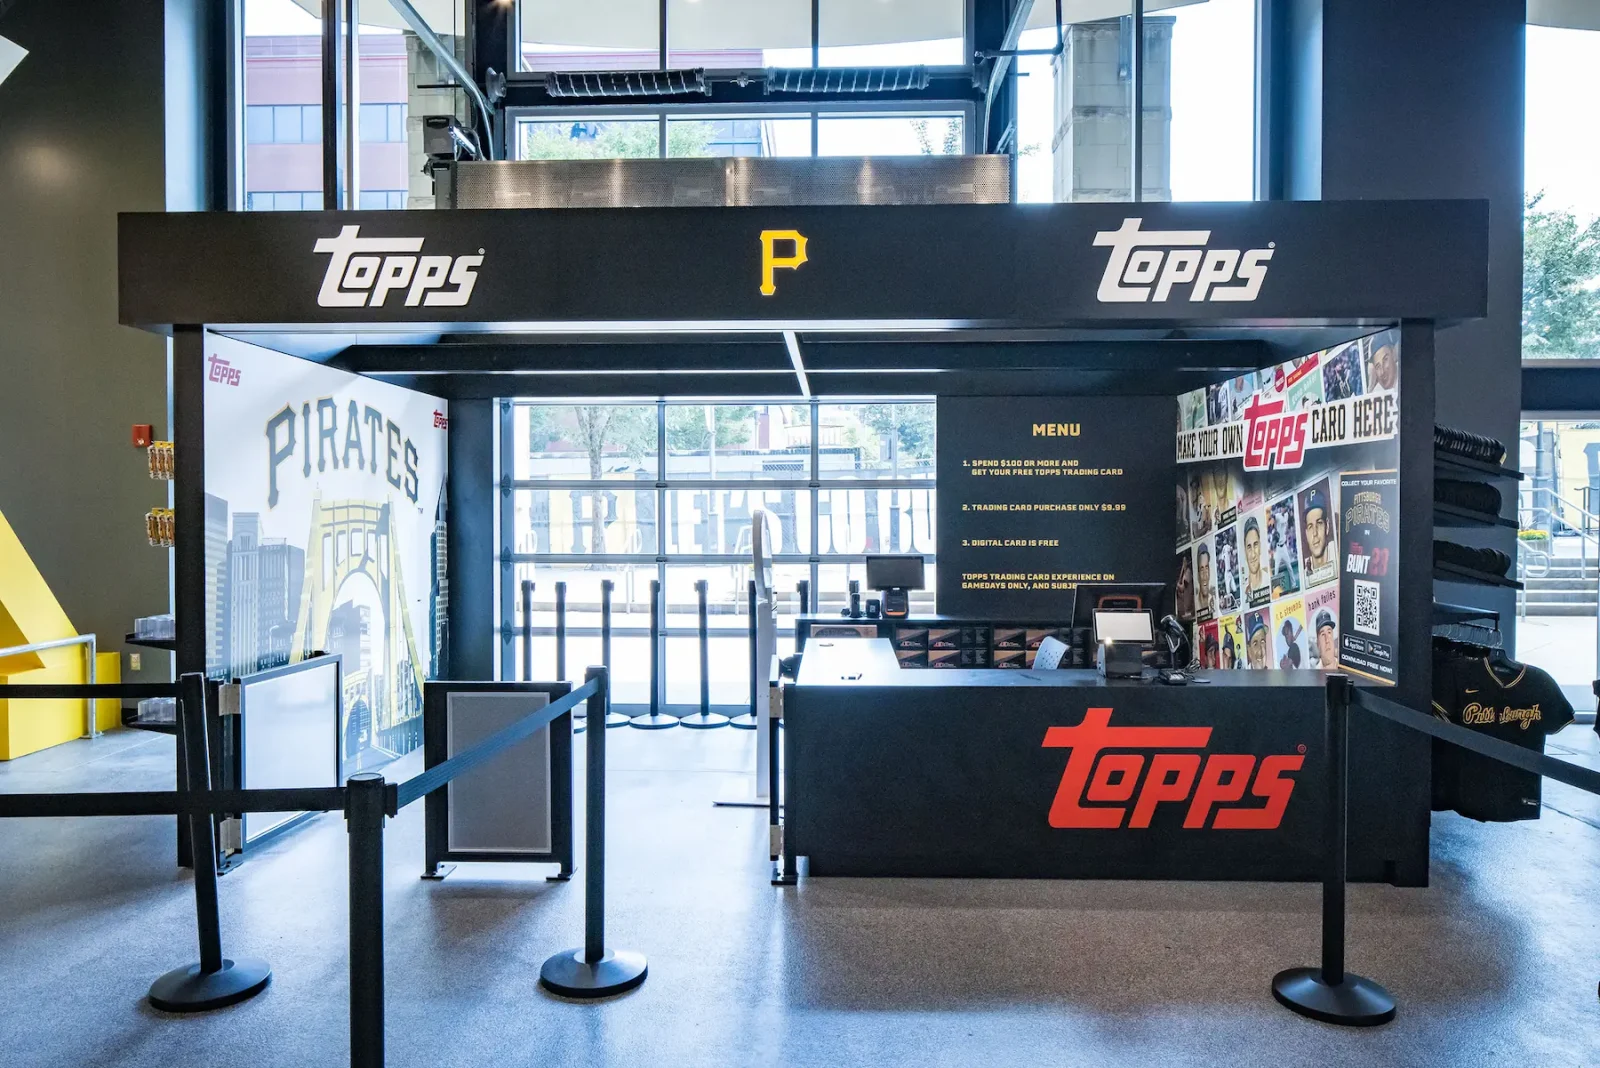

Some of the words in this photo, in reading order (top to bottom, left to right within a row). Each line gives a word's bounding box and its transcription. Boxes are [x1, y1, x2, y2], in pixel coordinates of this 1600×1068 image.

[760, 230, 808, 295] P
[1032, 423, 1081, 437] MENU
[1177, 432, 1196, 460] MAKE
[1199, 428, 1218, 457] YOUR
[1222, 424, 1243, 455] OWN
[1311, 403, 1346, 444] CARD
[264, 396, 419, 509] PIRATES
[962, 459, 971, 467] 1.
[972, 459, 999, 467] SPEND
[1000, 459, 1023, 468] $100
[1024, 459, 1036, 467] OR
[1037, 459, 1060, 467] MORE
[1061, 459, 1079, 467] AND
[971, 468, 988, 476] GET
[989, 468, 1011, 476] YOUR
[1012, 468, 1034, 476] FREE
[1035, 468, 1061, 476] TOPPS
[1062, 468, 1099, 476] TRADING
[1100, 468, 1124, 476] CARD
[1373, 478, 1396, 486] FAVORITE
[962, 503, 971, 511] 2.
[972, 503, 1008, 511] TRADING
[1009, 503, 1033, 511] CARD
[1033, 503, 1078, 511] PURCHASE
[1078, 503, 1100, 511] ONLY
[1101, 503, 1127, 512] $9.99
[1345, 503, 1390, 533] PIRATES
[962, 539, 971, 547] 3.
[971, 539, 1003, 547] DIGITAL
[1004, 539, 1027, 547] CARD
[1028, 539, 1037, 547] IS
[1038, 539, 1060, 547] FREE
[1346, 553, 1371, 575] BUNT
[961, 573, 989, 581] TOPPS
[989, 573, 1026, 581] TRADING
[1027, 573, 1050, 581] CARD
[1051, 573, 1102, 581] EXPERIENCE
[1103, 573, 1115, 581] ON
[961, 582, 1006, 590] GAMEDAYS
[1007, 582, 1031, 591] ONLY,
[1032, 582, 1050, 590] AND
[1341, 654, 1366, 666] DOWNLOAD
[1366, 661, 1379, 670] FREE
